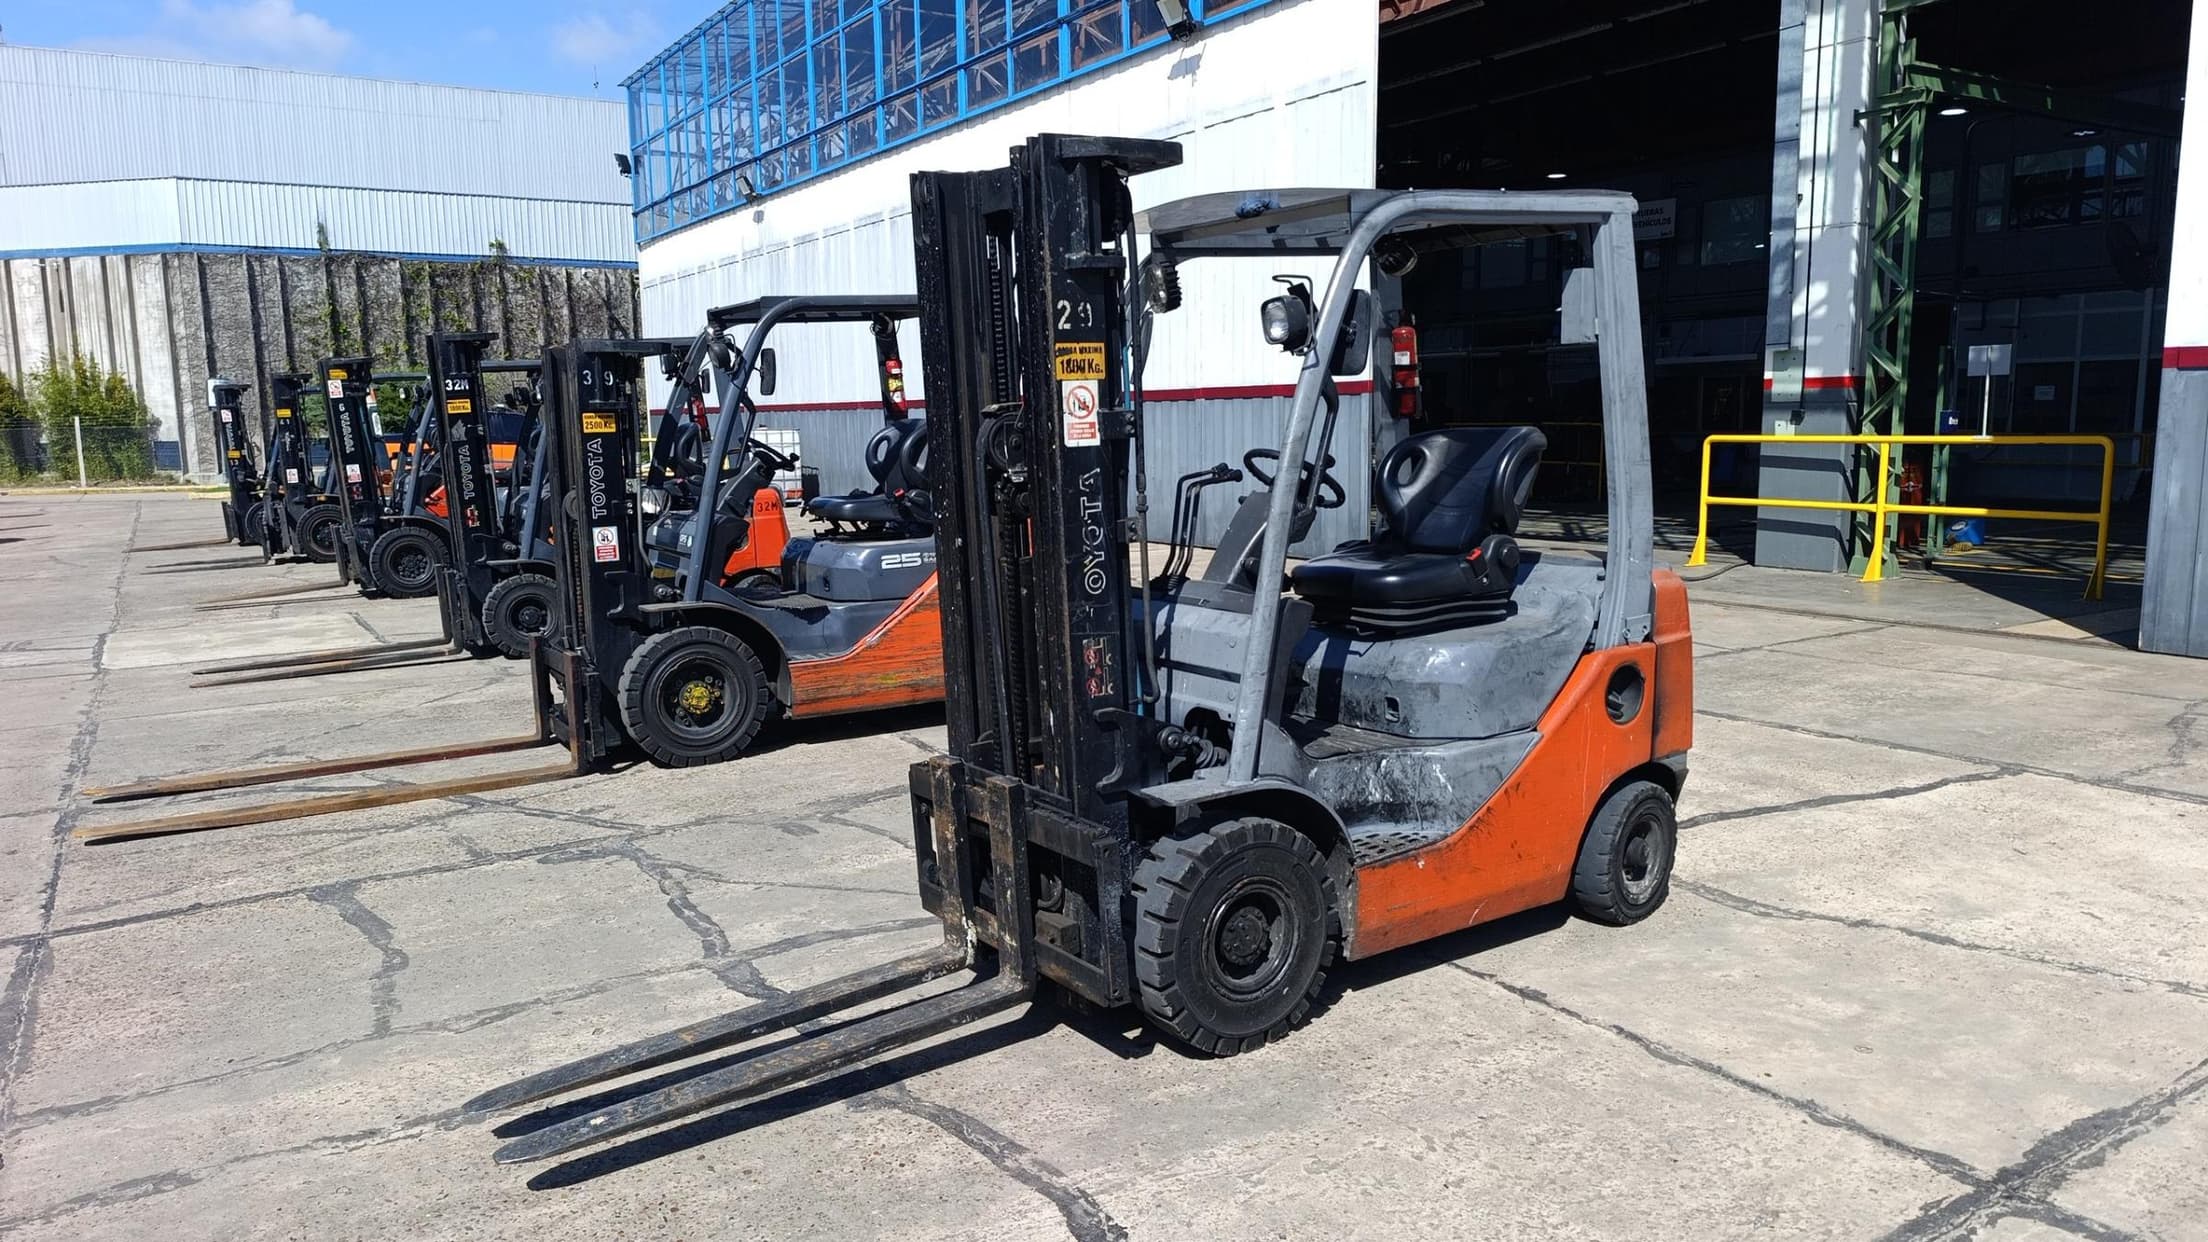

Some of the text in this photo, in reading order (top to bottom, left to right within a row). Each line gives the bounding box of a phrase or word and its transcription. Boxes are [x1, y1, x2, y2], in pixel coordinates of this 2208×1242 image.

[1056, 299, 1093, 330] 29
[445, 379, 469, 391] 32M
[340, 412, 355, 454] TOYOTA
[585, 420, 603, 430] 2500
[458, 444, 476, 500] TOYOTA
[587, 438, 607, 520] TOYOTA
[757, 501, 778, 512] 32M
[1080, 467, 1106, 600] OYOTA
[881, 552, 922, 569] 25
